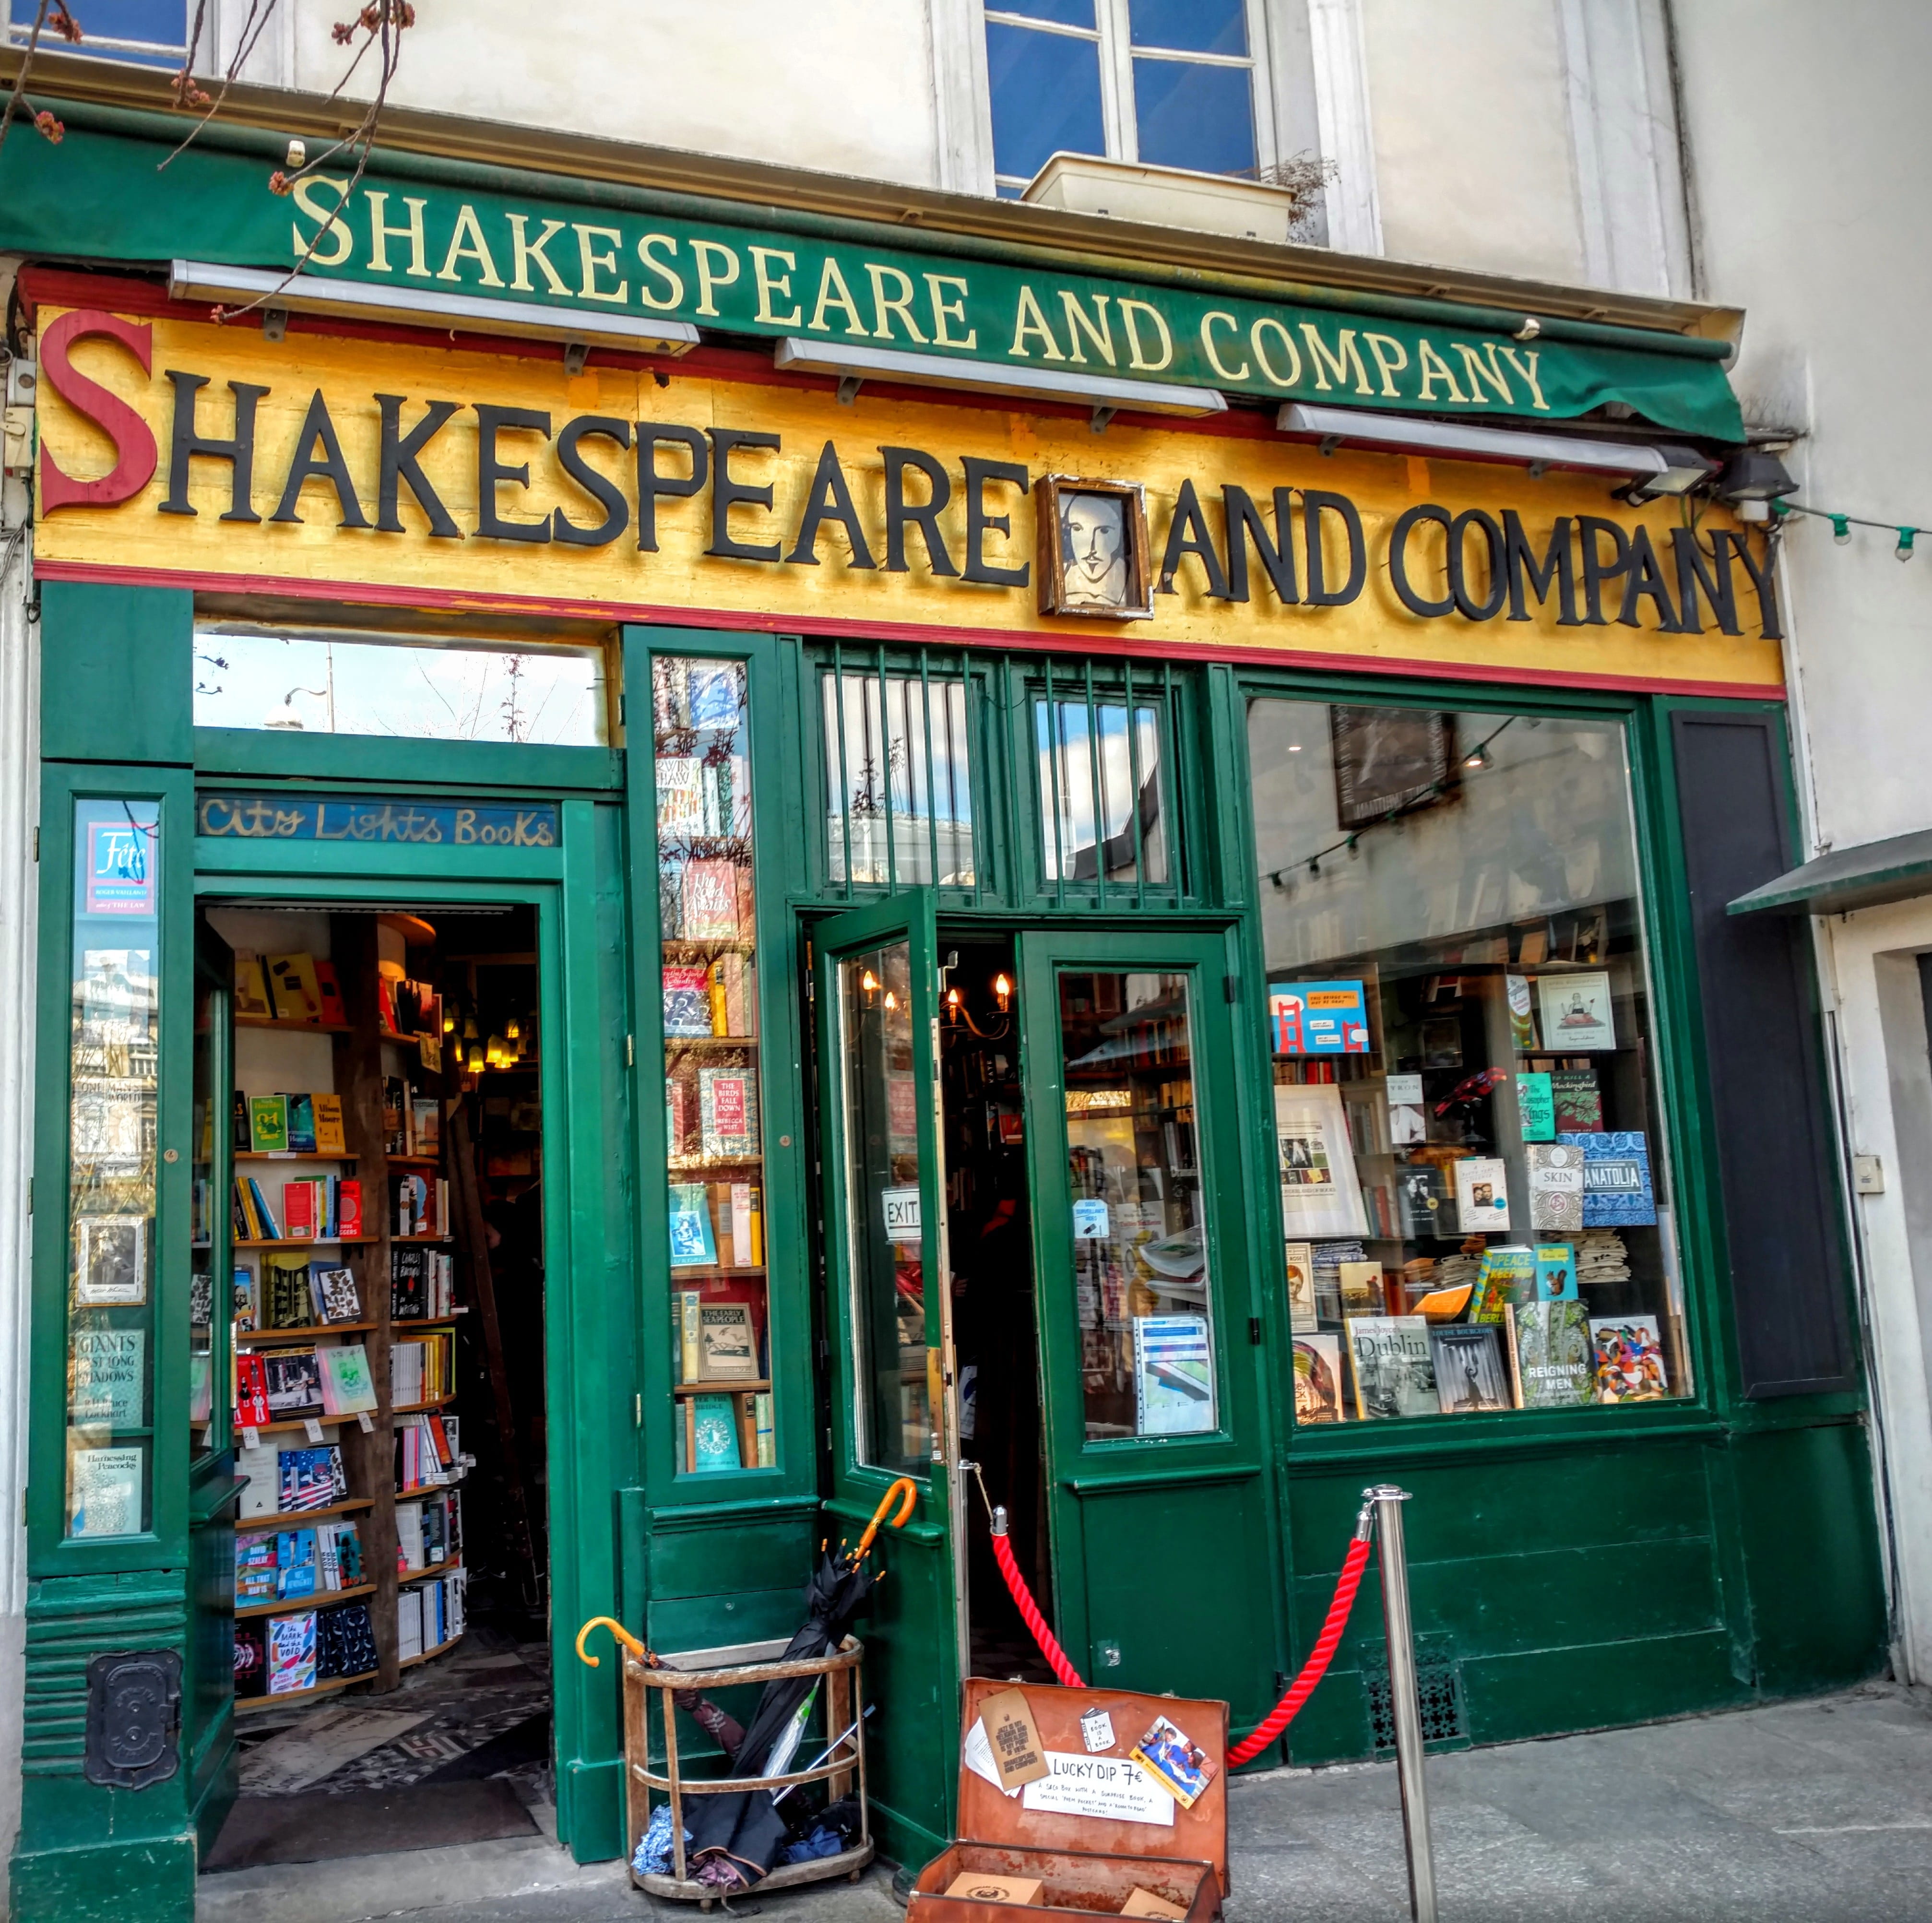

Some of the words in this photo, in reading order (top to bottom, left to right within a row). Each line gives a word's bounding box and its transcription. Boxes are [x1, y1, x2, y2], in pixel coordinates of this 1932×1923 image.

[291, 174, 977, 350] SHAKESPEARE
[1008, 285, 1173, 372] AND
[1200, 311, 1551, 411] COMPANY
[39, 309, 1031, 588] SHAKESPEARE
[1155, 478, 1367, 606] AND
[1389, 504, 1784, 641] COMPANY
[201, 798, 306, 837] City
[316, 803, 442, 843] Lights
[454, 808, 554, 847] Books
[96, 831, 146, 874] Fête
[1552, 1080, 1597, 1092] Mockingbird
[1543, 1172, 1573, 1183] SKIN
[1584, 1167, 1640, 1189] ANATOLIA
[1355, 1326, 1376, 1337] James
[80, 1335, 136, 1353] GIANTS
[1356, 1334, 1427, 1357] Dublin
[1529, 1364, 1587, 1378] REIGNING
[1546, 1378, 1573, 1390] MEN
[245, 1577, 256, 1585] ALL
[281, 1633, 303, 1641] MARK
[281, 1647, 300, 1657] VOID
[1005, 1765, 1015, 1774] AND
[1015, 1757, 1038, 1770] COMPANY
[1054, 1758, 1094, 1779] LUCKY
[1097, 1764, 1117, 1782] DIP
[1101, 1790, 1125, 1799] SURPRISE
